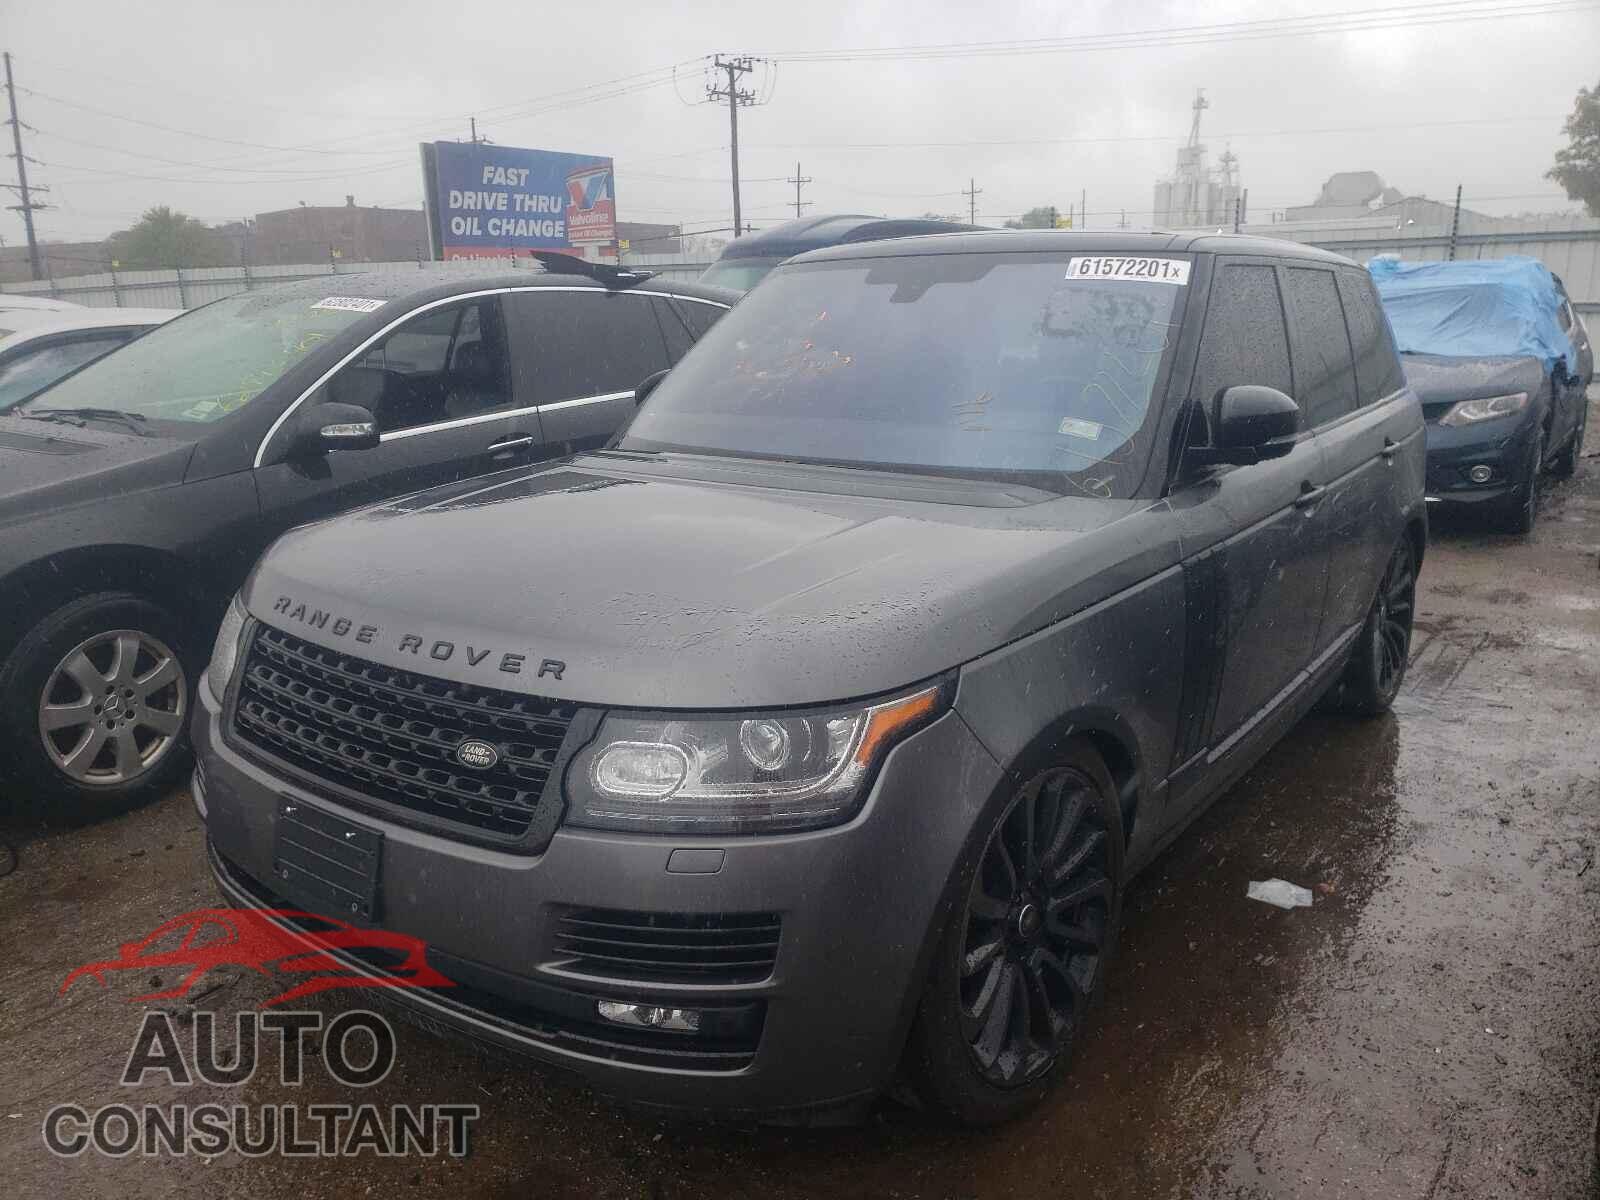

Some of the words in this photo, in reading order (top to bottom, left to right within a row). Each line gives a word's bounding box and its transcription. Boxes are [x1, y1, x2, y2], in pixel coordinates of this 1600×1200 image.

[482, 165, 529, 186] FAST
[449, 190, 508, 211] DRIVE
[513, 193, 562, 214] THRU
[451, 216, 482, 236] OIL
[487, 218, 565, 238] CHANGE
[273, 597, 377, 644] RANGE
[398, 633, 567, 681] ROVER
